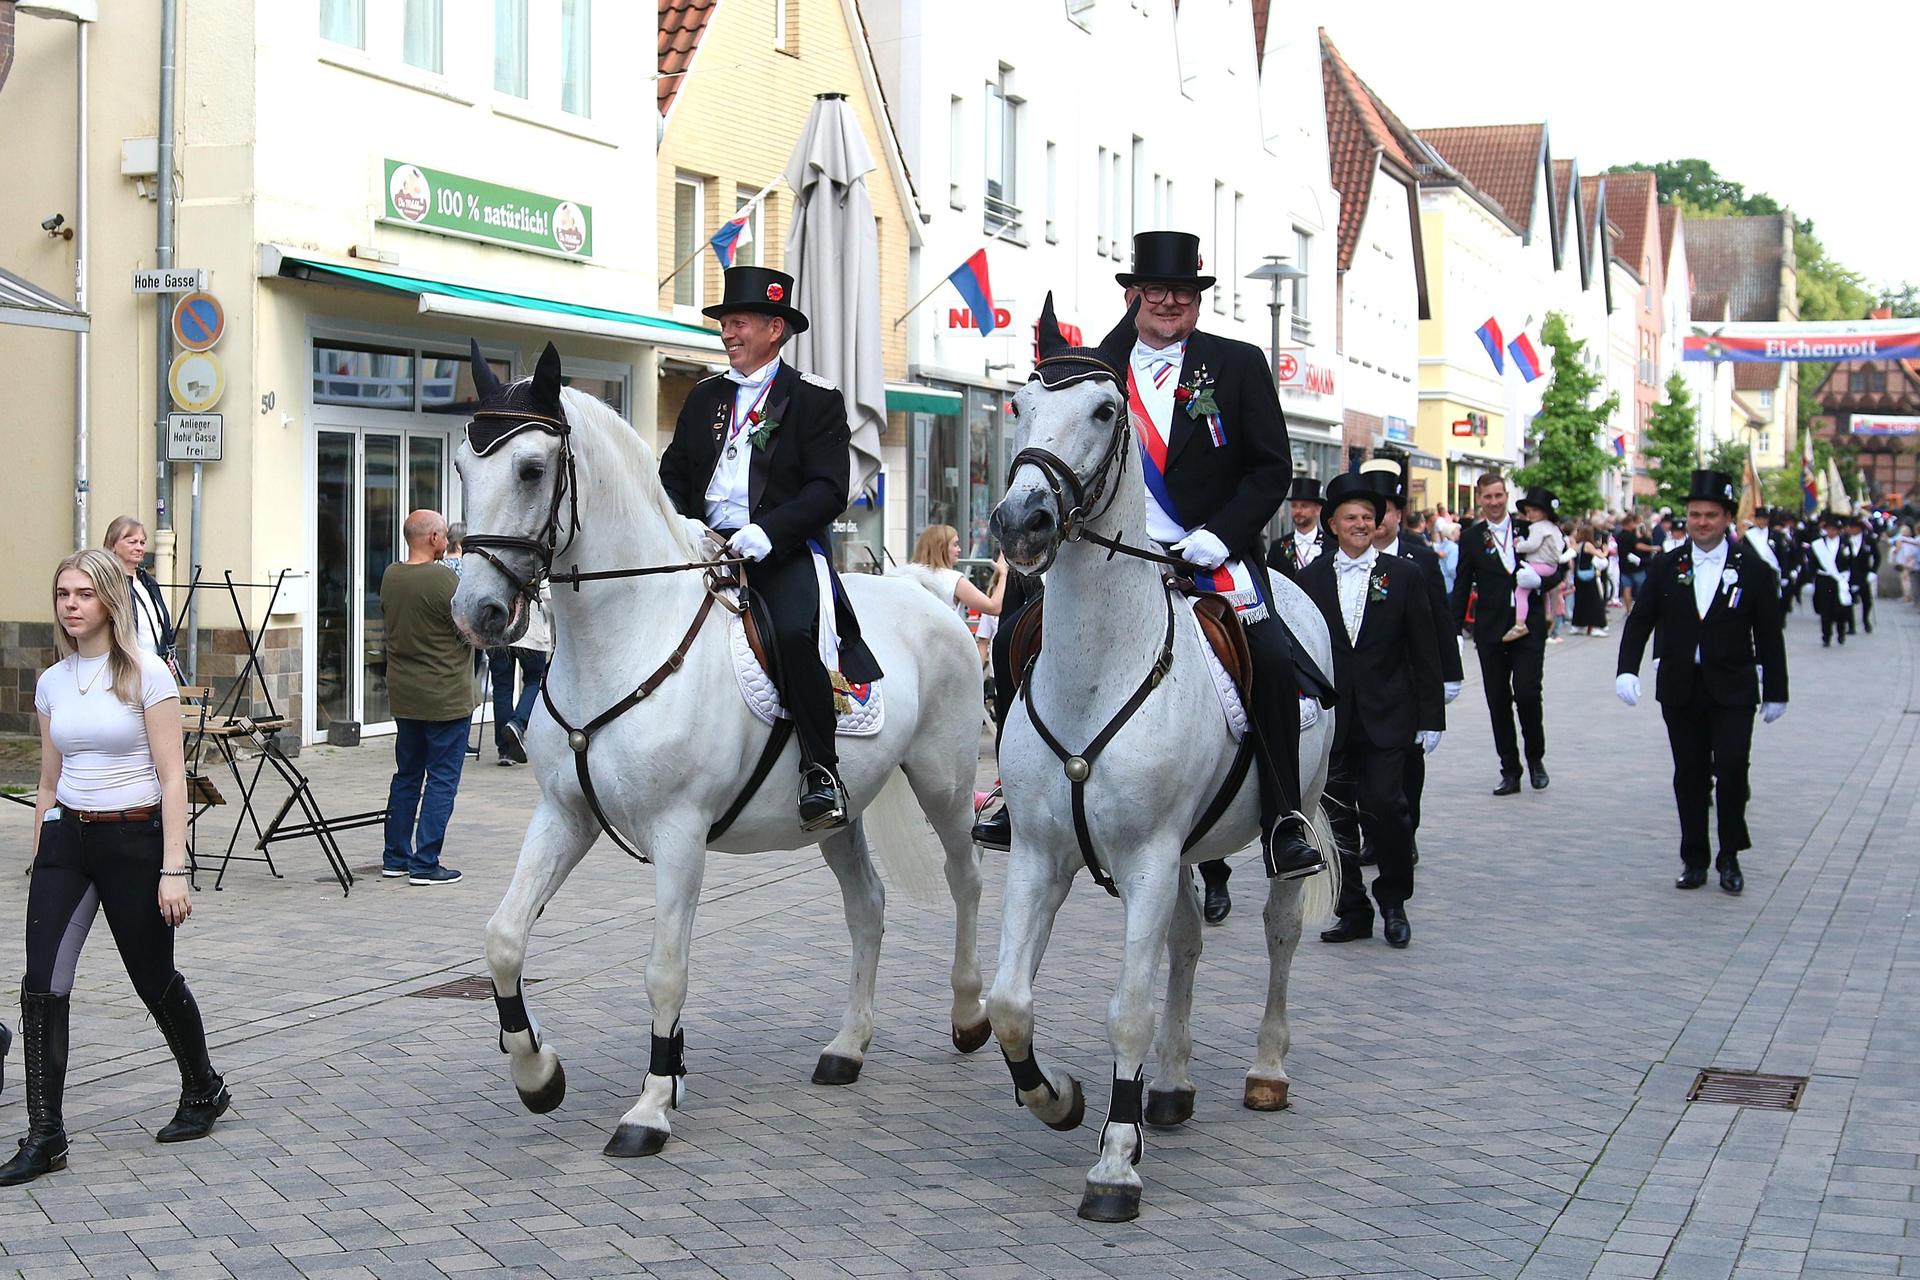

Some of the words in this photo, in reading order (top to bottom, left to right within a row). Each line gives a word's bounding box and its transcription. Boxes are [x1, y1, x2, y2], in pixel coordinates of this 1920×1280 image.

[436, 187, 463, 218] 100
[467, 193, 480, 222] %
[483, 203, 549, 236] natürlich!
[134, 274, 160, 289] Hohe
[164, 273, 195, 288] Gasse
[260, 391, 276, 415] 50
[179, 418, 211, 432] Anlieger
[173, 430, 192, 442] Hohe
[194, 430, 217, 443] Gasse
[185, 445, 204, 457] frei
